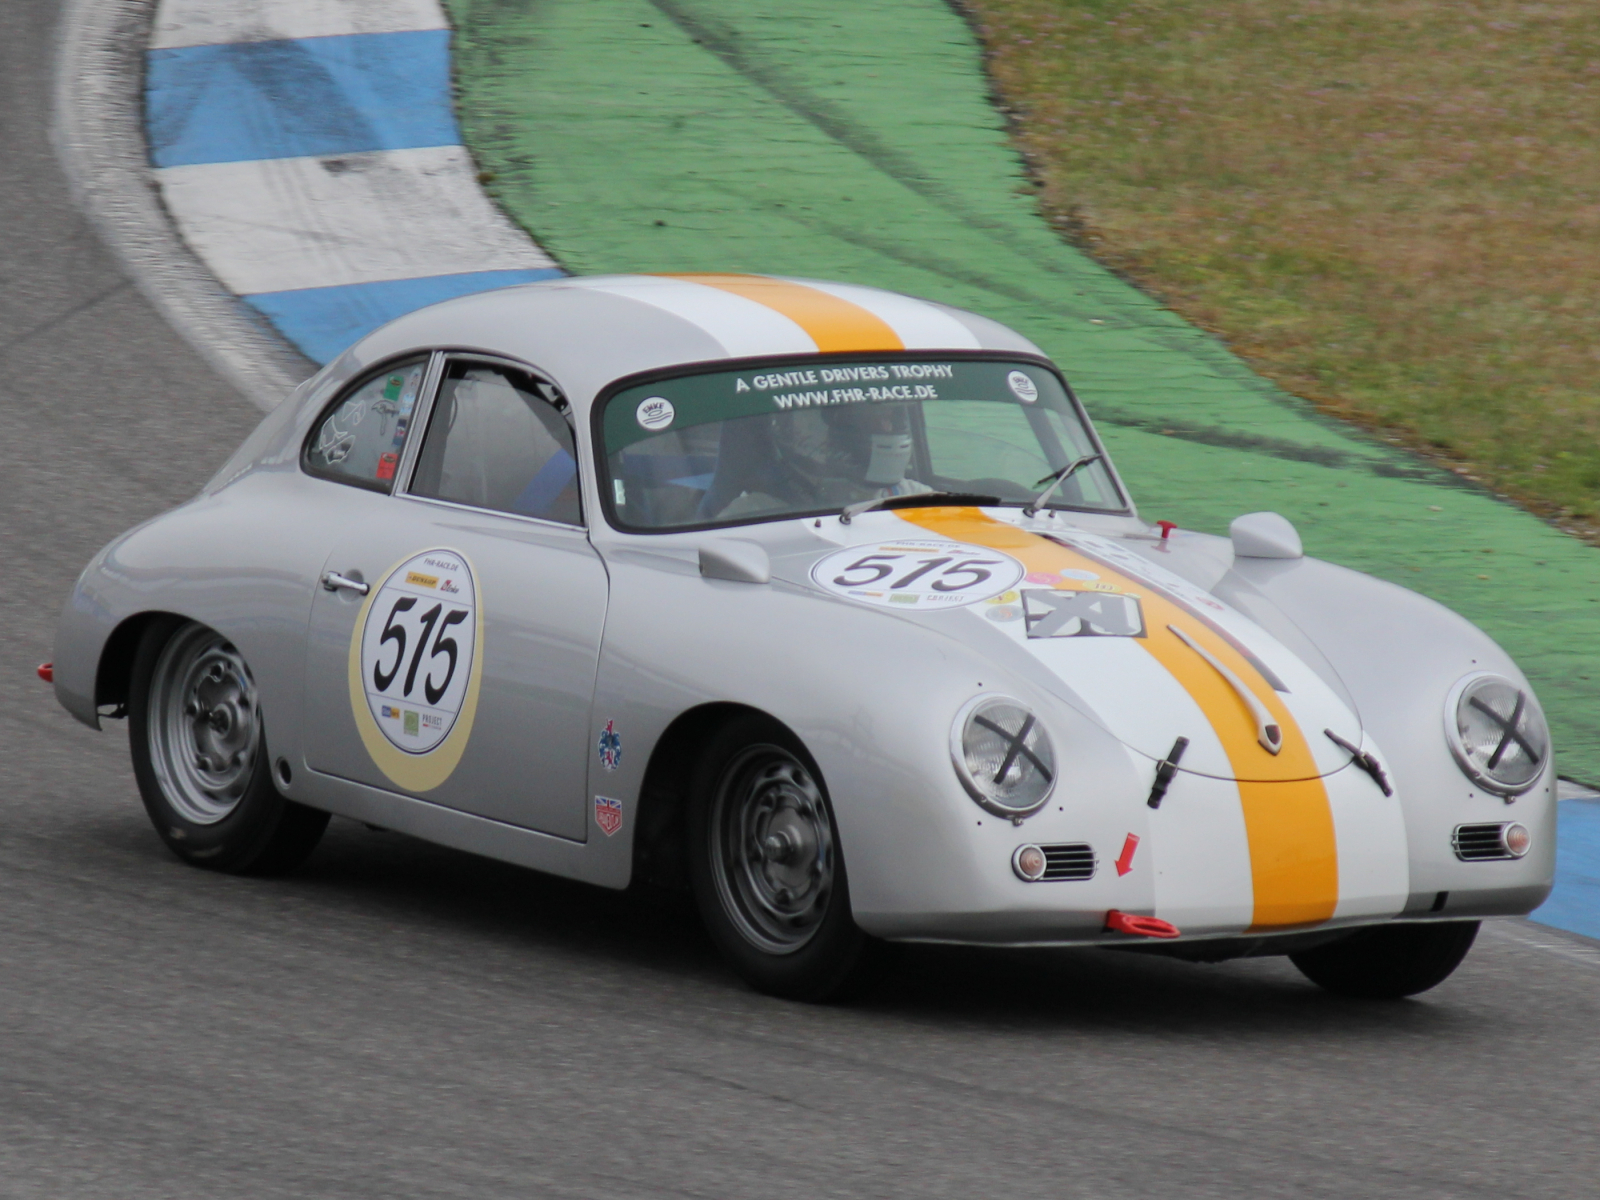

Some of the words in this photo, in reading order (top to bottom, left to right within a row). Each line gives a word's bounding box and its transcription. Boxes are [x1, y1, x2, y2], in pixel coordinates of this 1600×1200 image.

[736, 378, 750, 393] A
[753, 370, 818, 390] GENTLE
[820, 366, 889, 384] DRIVERS
[891, 365, 953, 380] TROPHY
[773, 385, 938, 409] WWW.FHR-RACE.DE
[833, 554, 1005, 592] 515
[373, 596, 469, 706] 515
[422, 713, 443, 726] PROJECT
